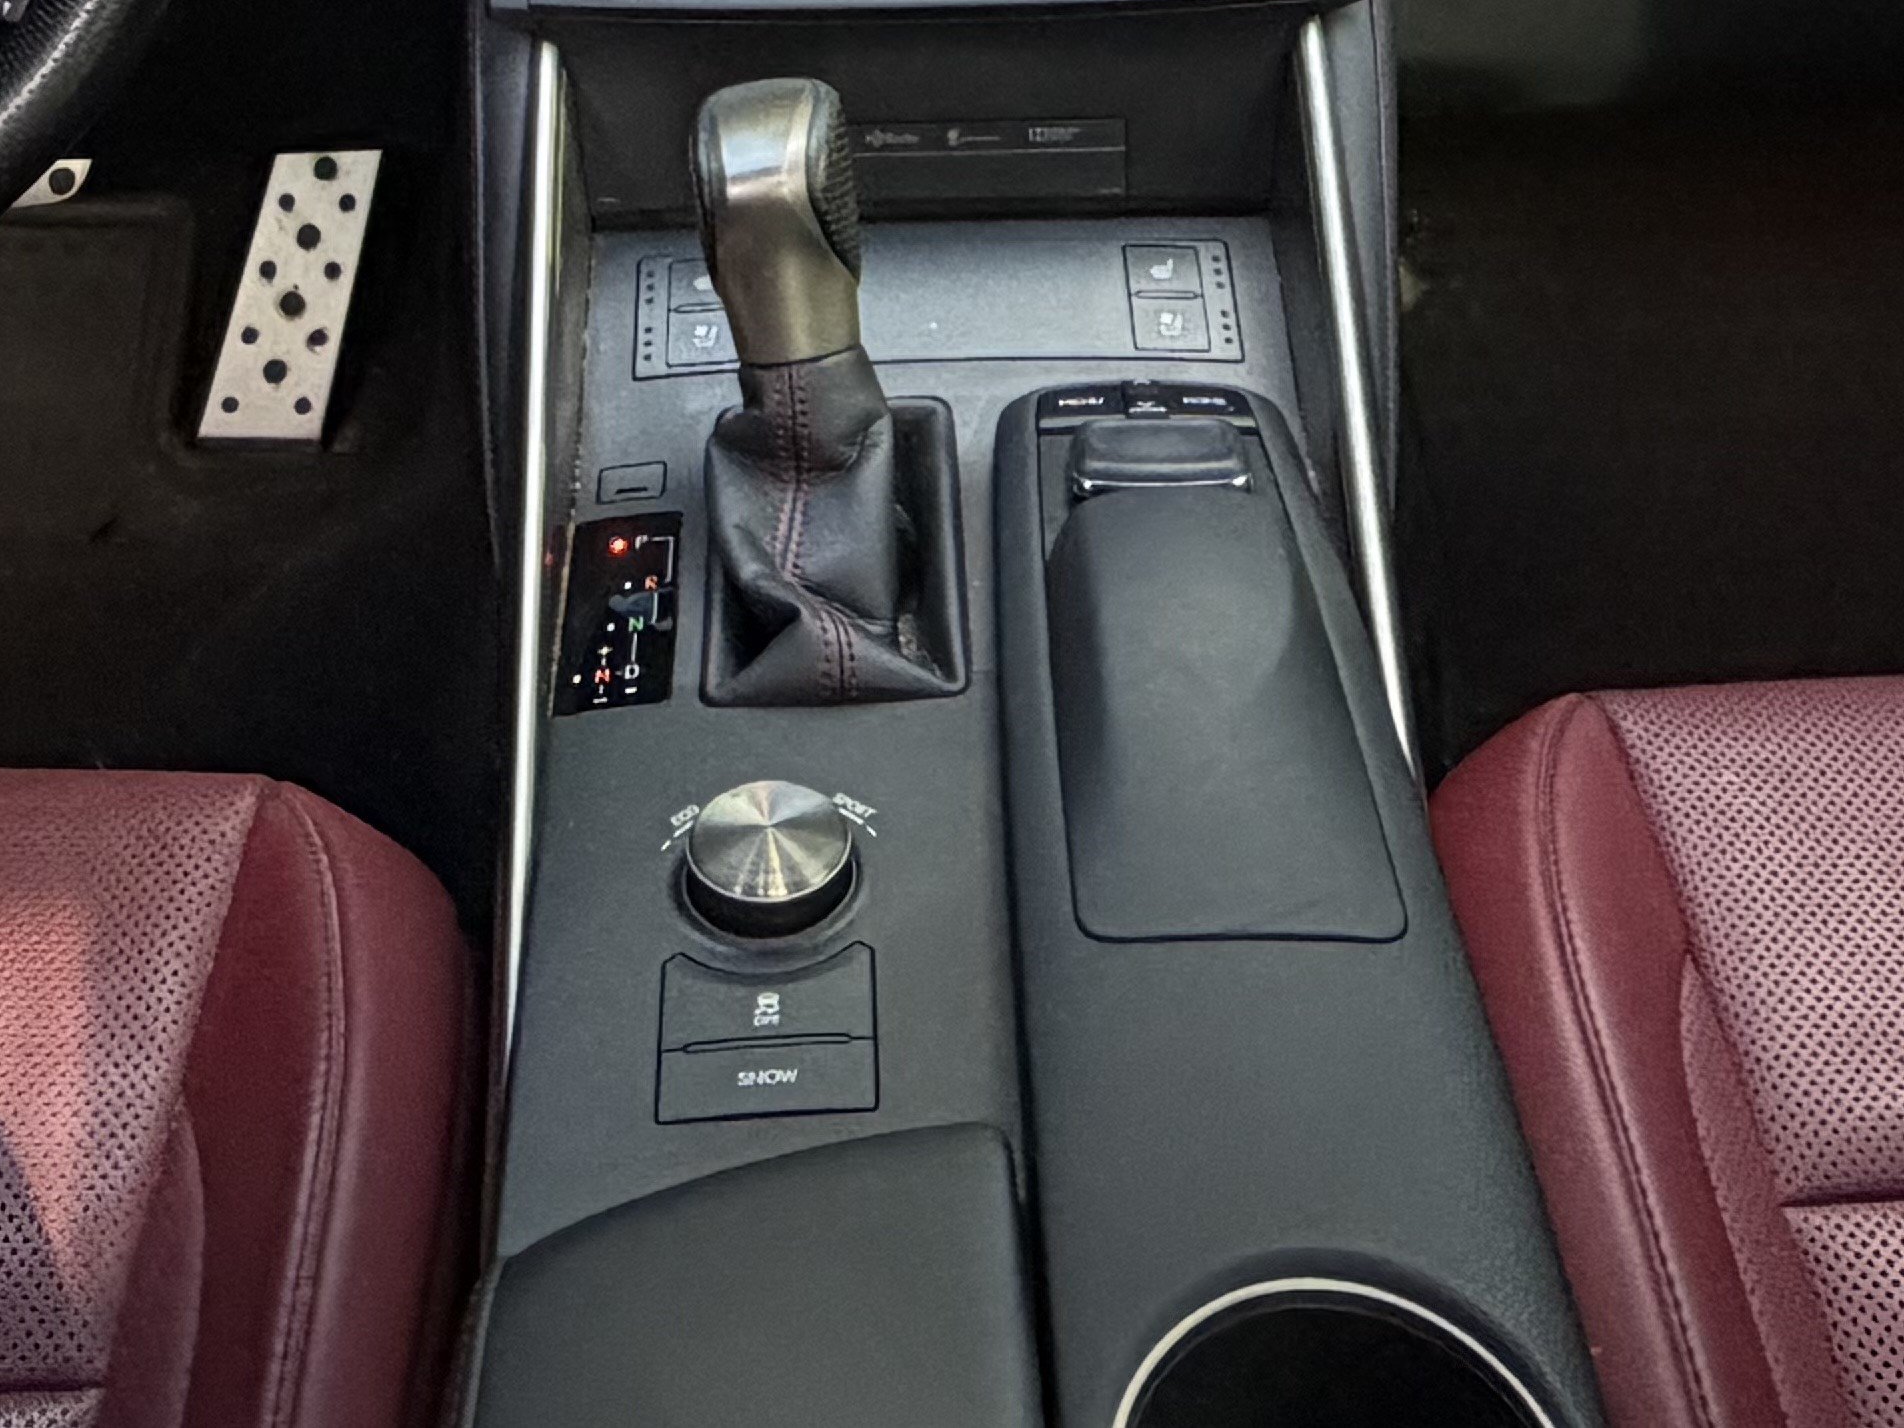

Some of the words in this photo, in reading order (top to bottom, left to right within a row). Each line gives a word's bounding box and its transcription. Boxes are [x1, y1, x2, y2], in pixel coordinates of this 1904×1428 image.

[628, 615, 645, 632] N
[624, 663, 641, 681] D
[669, 803, 701, 828] ECO
[737, 1068, 799, 1087] SNOW
